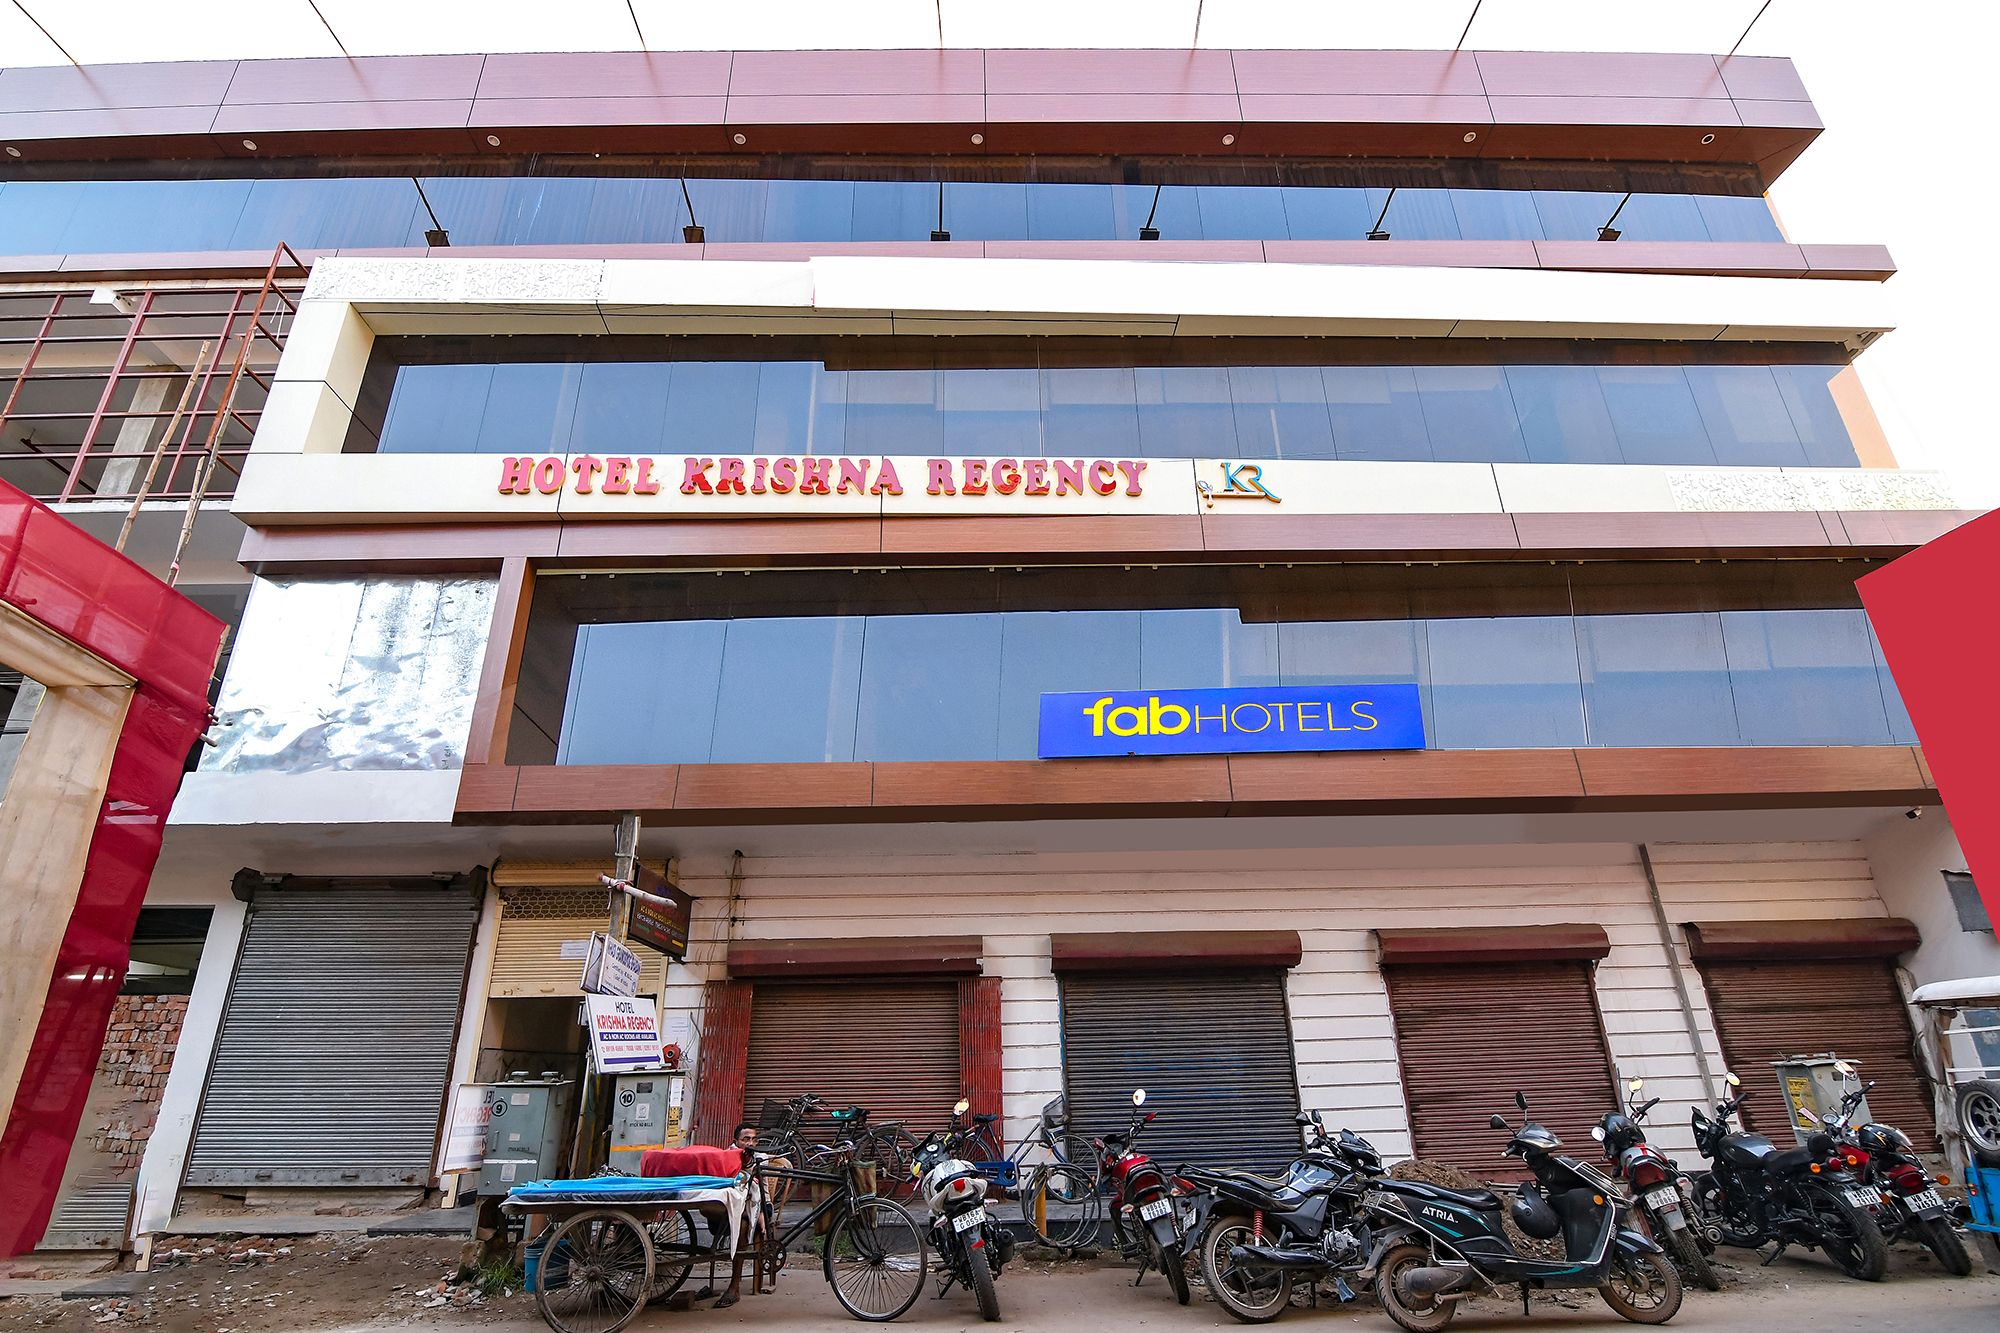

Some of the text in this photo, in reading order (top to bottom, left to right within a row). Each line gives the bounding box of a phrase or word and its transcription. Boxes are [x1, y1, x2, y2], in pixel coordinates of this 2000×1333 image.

[497, 454, 1147, 497] HOTEL KRISHNA REGENCY
[614, 1002, 634, 1014] HOTEL
[596, 1014, 626, 1030] KRISHNA
[626, 1016, 656, 1030] REGENCY
[622, 1094, 632, 1104] 10
[496, 1104, 502, 1114] 9
[1422, 1205, 1454, 1223] ATRIA
